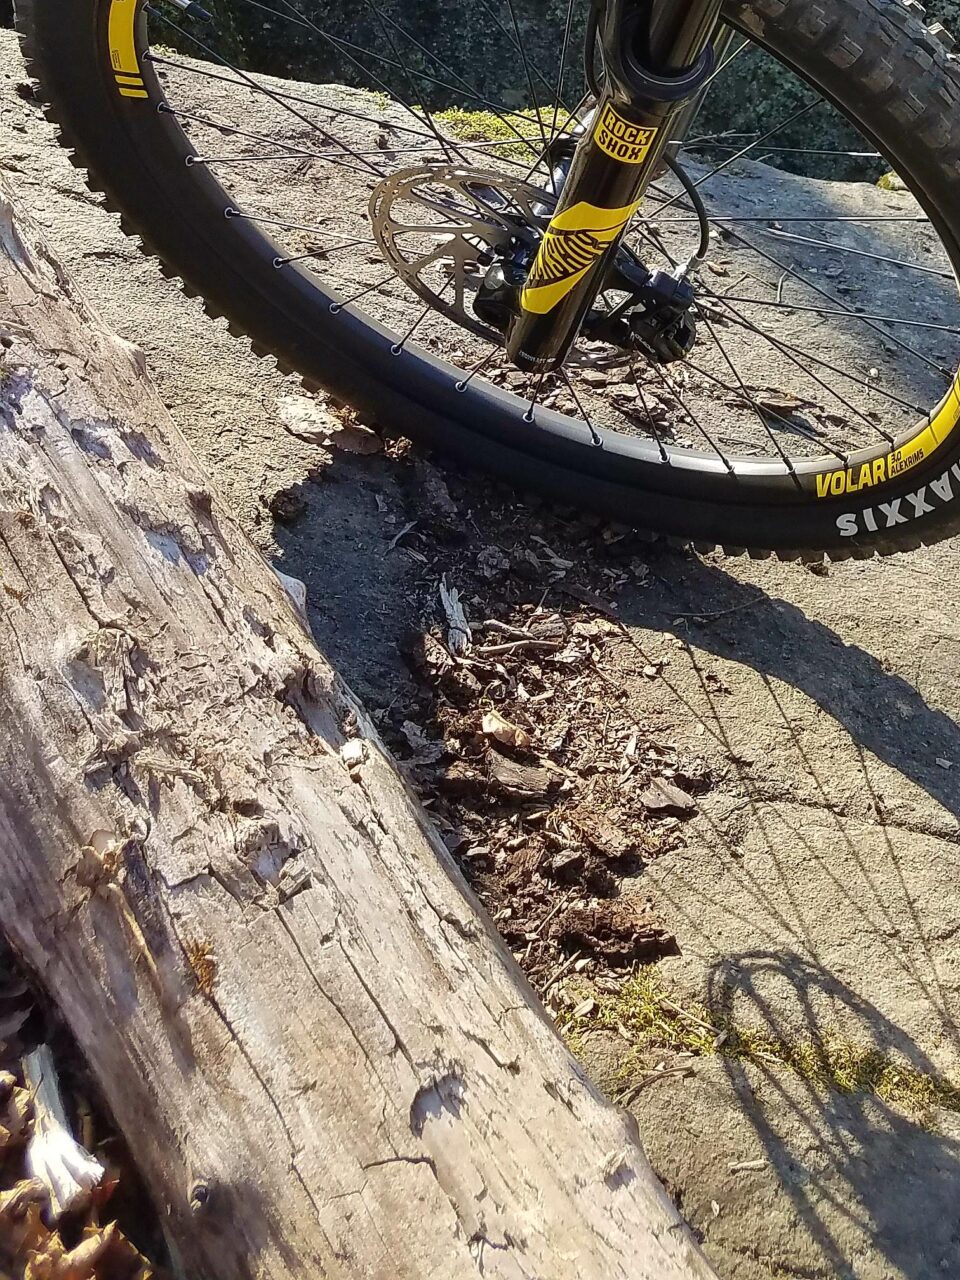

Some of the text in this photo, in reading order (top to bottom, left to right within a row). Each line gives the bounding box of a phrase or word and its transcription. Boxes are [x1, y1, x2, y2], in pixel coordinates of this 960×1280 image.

[604, 110, 651, 145] ROCK
[598, 128, 643, 161] SHOX
[890, 450, 902, 464] 3.0
[890, 449, 924, 476] ALEXRIMS
[815, 457, 886, 499] VOLAR
